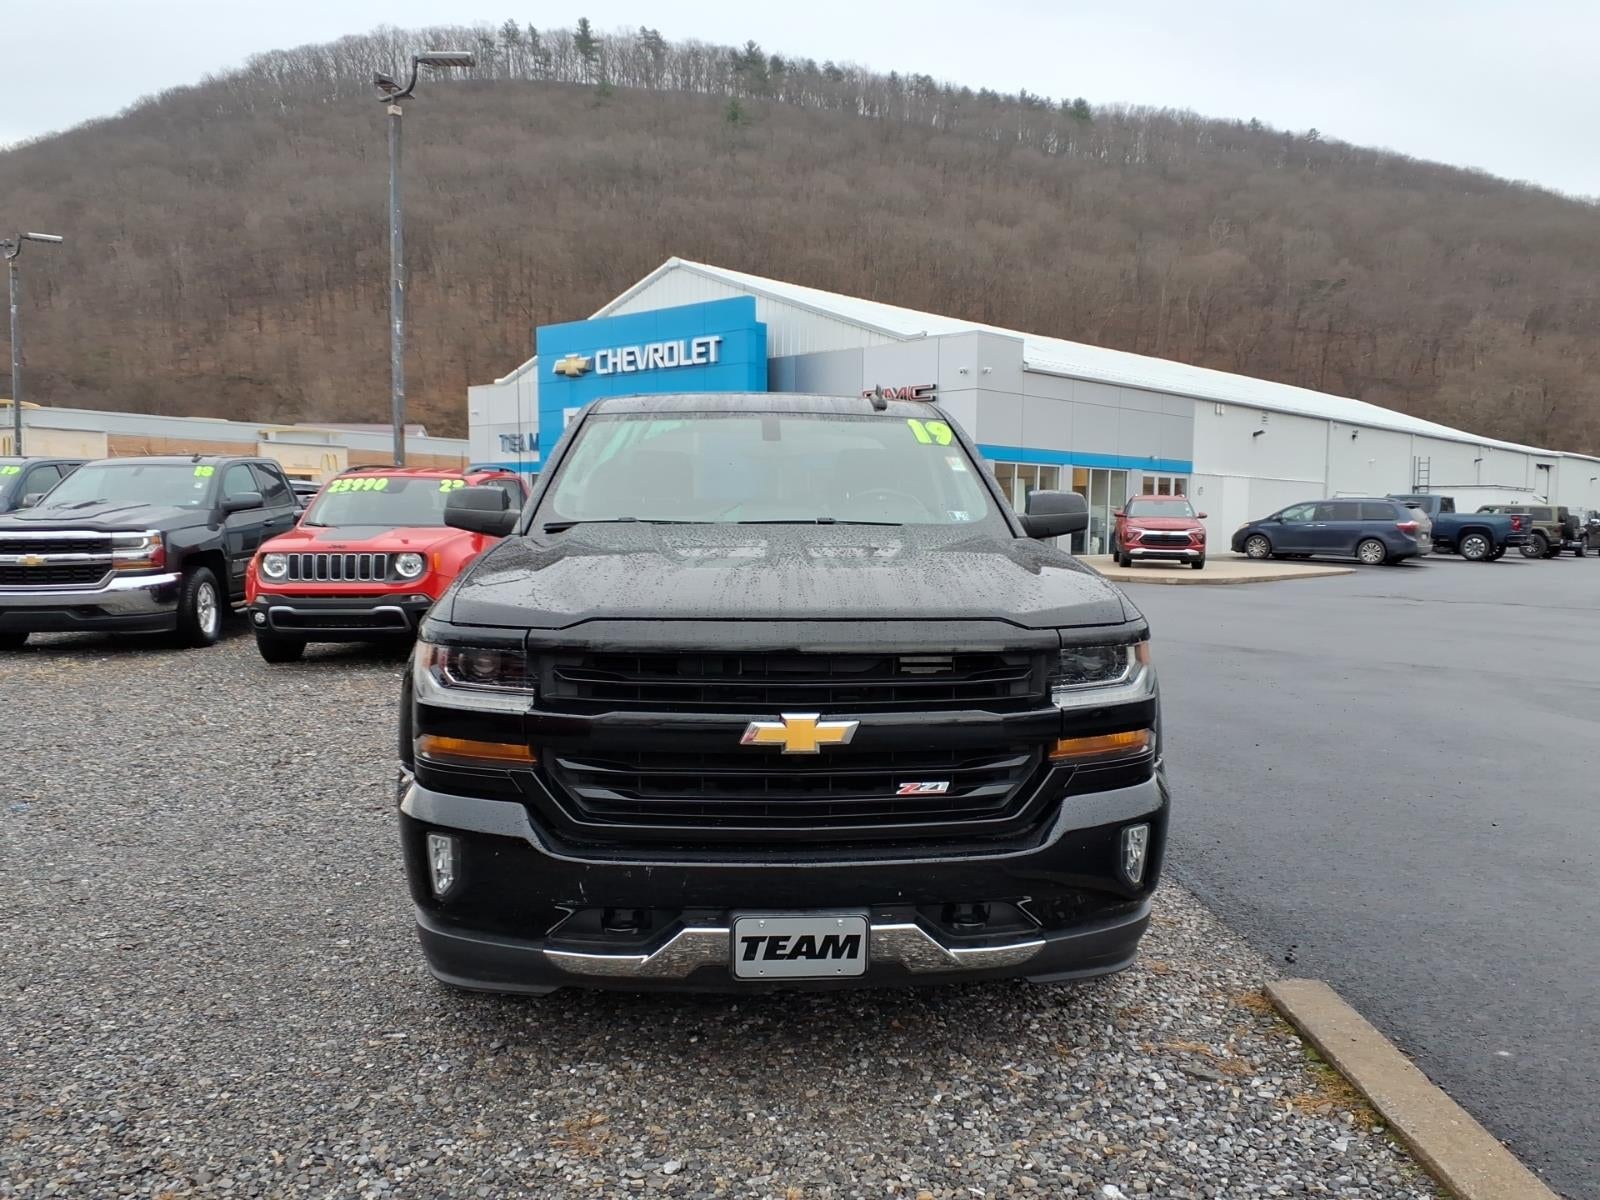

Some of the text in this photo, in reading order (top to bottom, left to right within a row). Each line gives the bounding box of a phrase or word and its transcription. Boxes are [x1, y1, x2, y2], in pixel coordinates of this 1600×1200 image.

[595, 335, 722, 375] CHEVROLET
[907, 418, 952, 446] 19
[327, 477, 389, 493] 23990
[896, 781, 950, 795] Z71
[740, 934, 862, 961] TEAM
